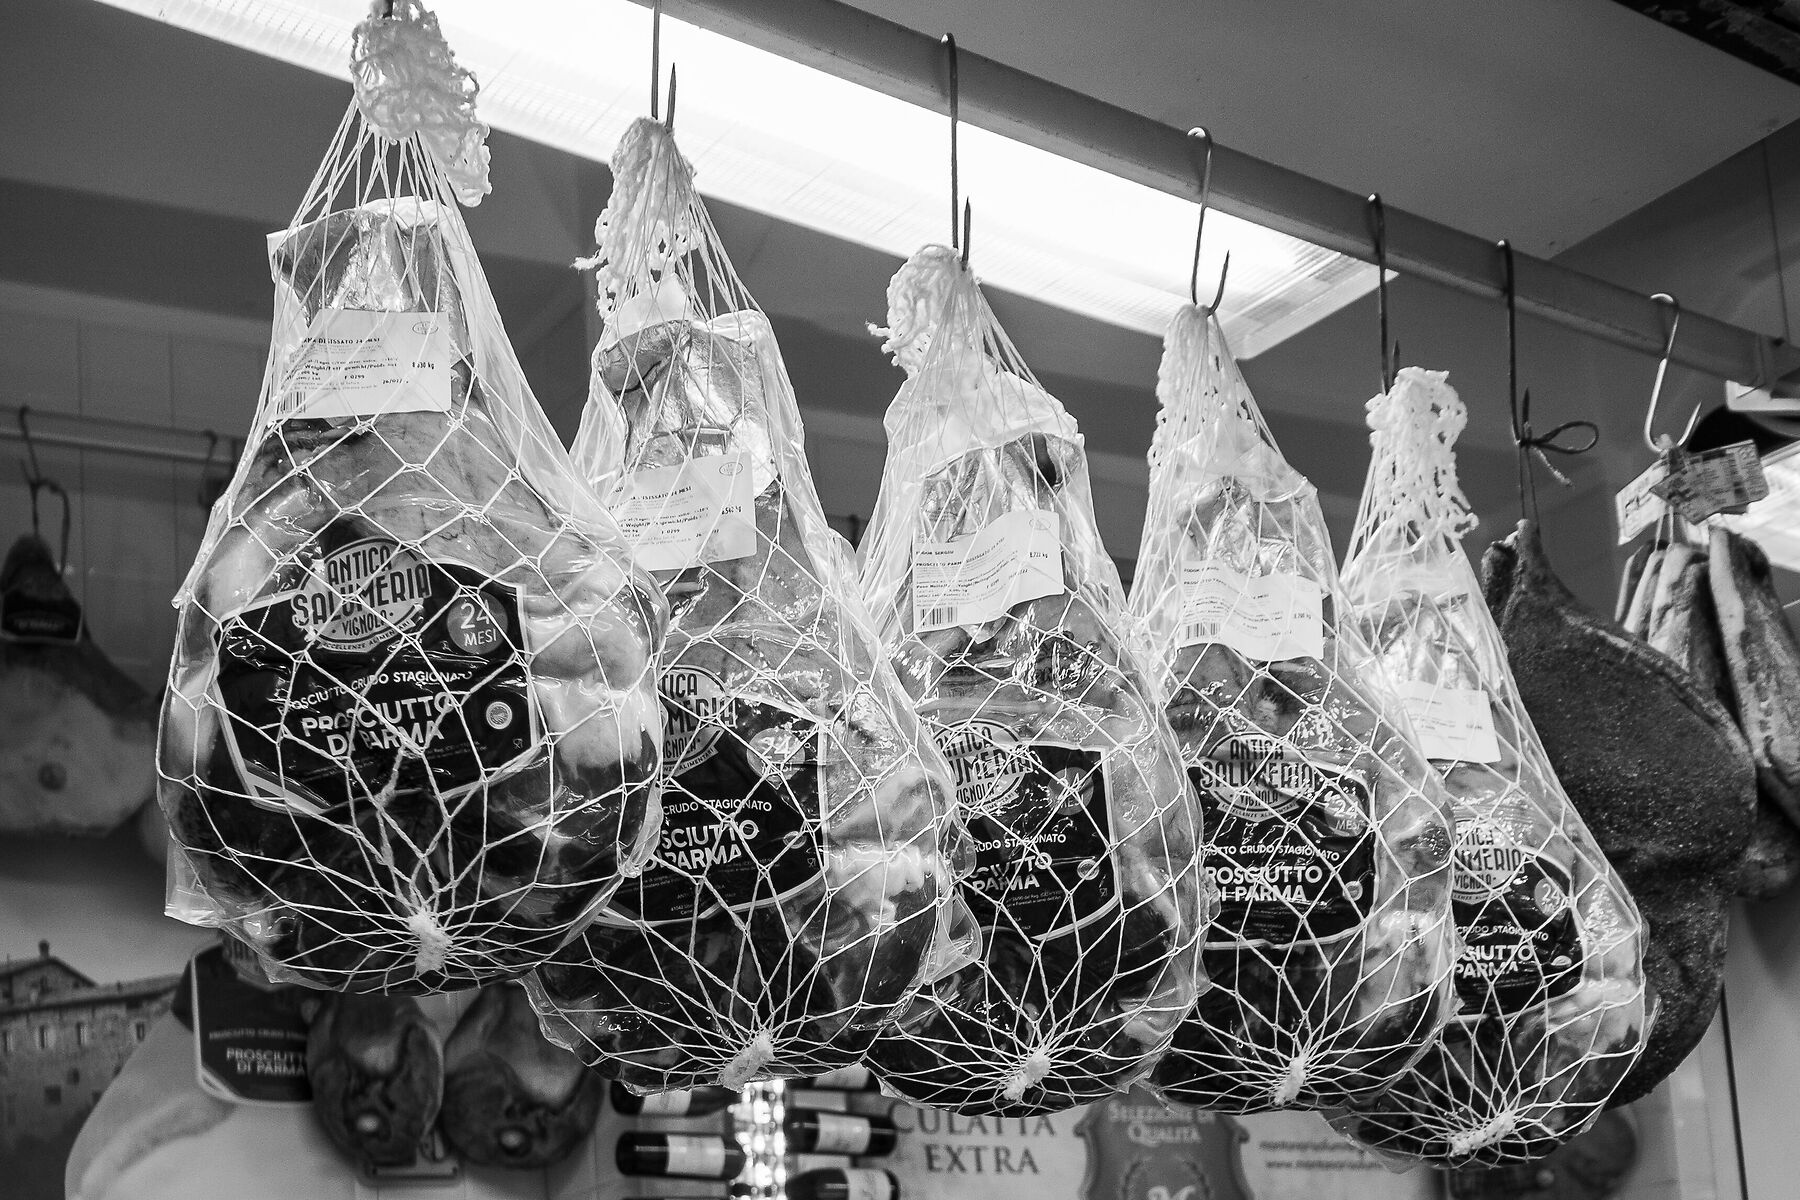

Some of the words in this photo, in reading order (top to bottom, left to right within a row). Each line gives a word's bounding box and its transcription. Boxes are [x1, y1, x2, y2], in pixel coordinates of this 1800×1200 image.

[327, 545, 392, 585] ANTICA
[293, 562, 432, 626] SALUMERIA
[342, 610, 387, 636] VIGNOLA
[460, 601, 490, 629] 24
[369, 621, 411, 646] ALIMENARI
[464, 630, 497, 647] MESI
[352, 673, 389, 691] CRUDO
[661, 673, 698, 697] TICA
[302, 691, 454, 737] PROSCIUTTO
[327, 731, 356, 756] DI
[359, 720, 445, 749] PARMA
[662, 734, 698, 760] IGNOLA
[1230, 739, 1285, 760] ANTICA
[1201, 761, 1316, 790] SALUMERIA
[663, 801, 699, 816] CRUDO
[703, 799, 773, 813] STAGIONATO
[660, 819, 759, 851] SCIUTTO
[967, 837, 1001, 853] RUDO
[664, 843, 742, 870] PARMA
[1240, 845, 1275, 855] CRUDO
[1205, 865, 1323, 884] ROSCIUTTO
[1235, 885, 1307, 902] PARMA
[1456, 961, 1519, 979] PARMA
[226, 1047, 306, 1061] PROSCIUTT
[237, 1061, 252, 1073] DI
[257, 1062, 306, 1076] PARMA
[924, 1143, 1040, 1175] EXTRA
